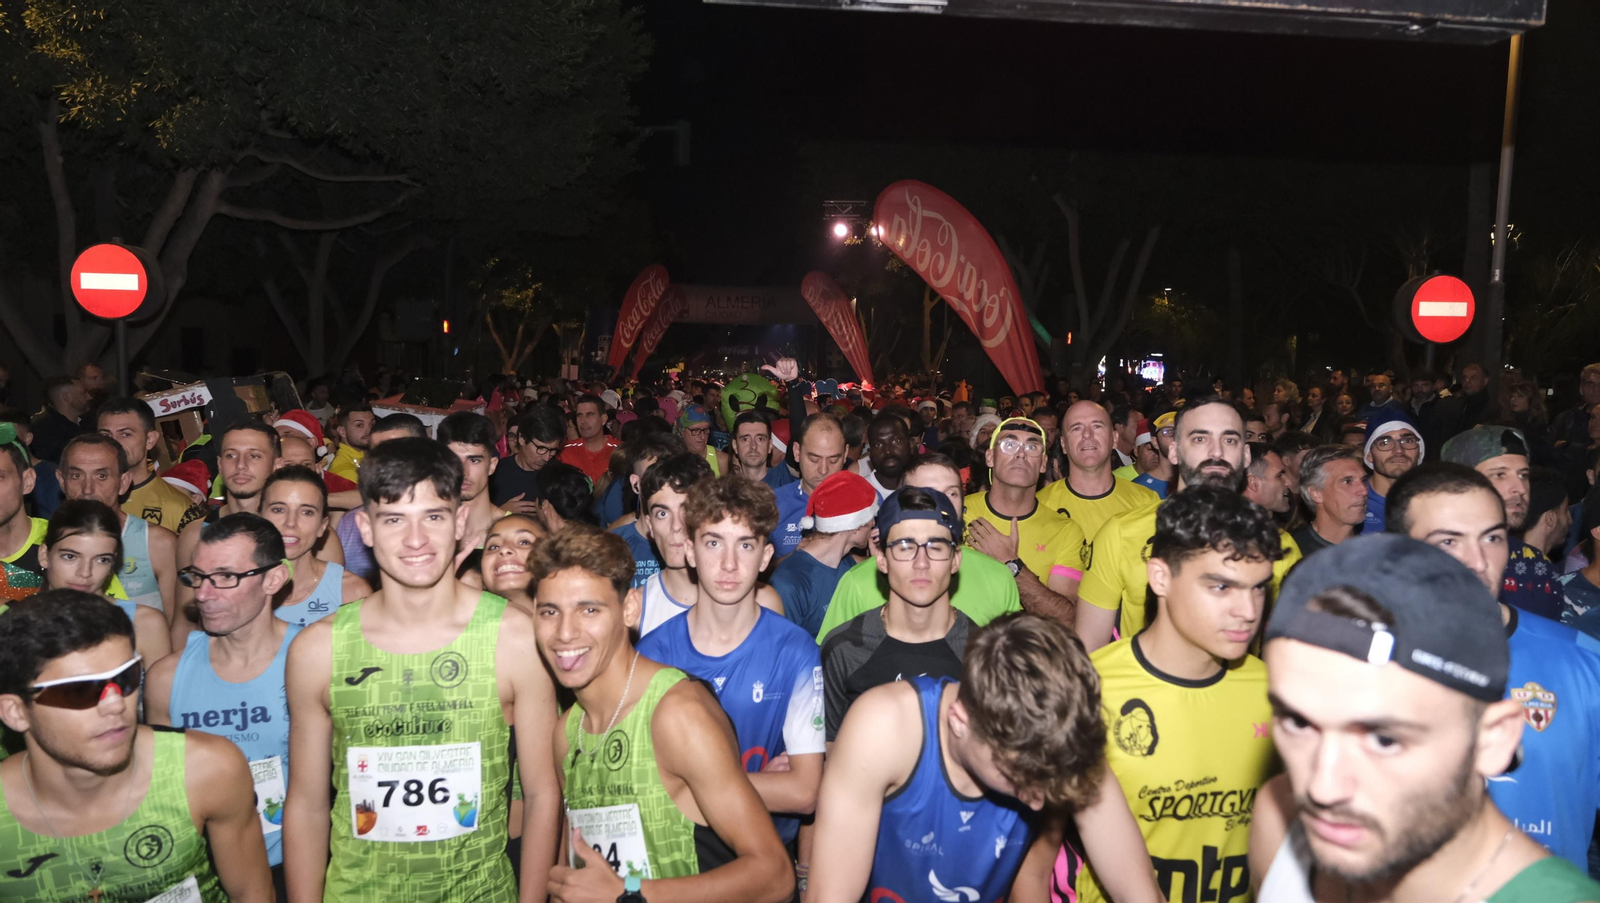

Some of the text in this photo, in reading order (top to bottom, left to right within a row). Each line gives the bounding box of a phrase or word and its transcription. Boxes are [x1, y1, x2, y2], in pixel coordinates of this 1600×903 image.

[705, 311, 742, 319] CIUDAD
[159, 392, 205, 413] Surbús
[181, 701, 271, 731] nerja
[419, 746, 473, 760] SILVESTRE
[416, 761, 429, 772] DE
[431, 757, 475, 771] ALMERIA
[377, 777, 450, 808] 786
[1138, 775, 1218, 799] Centro Deportivo
